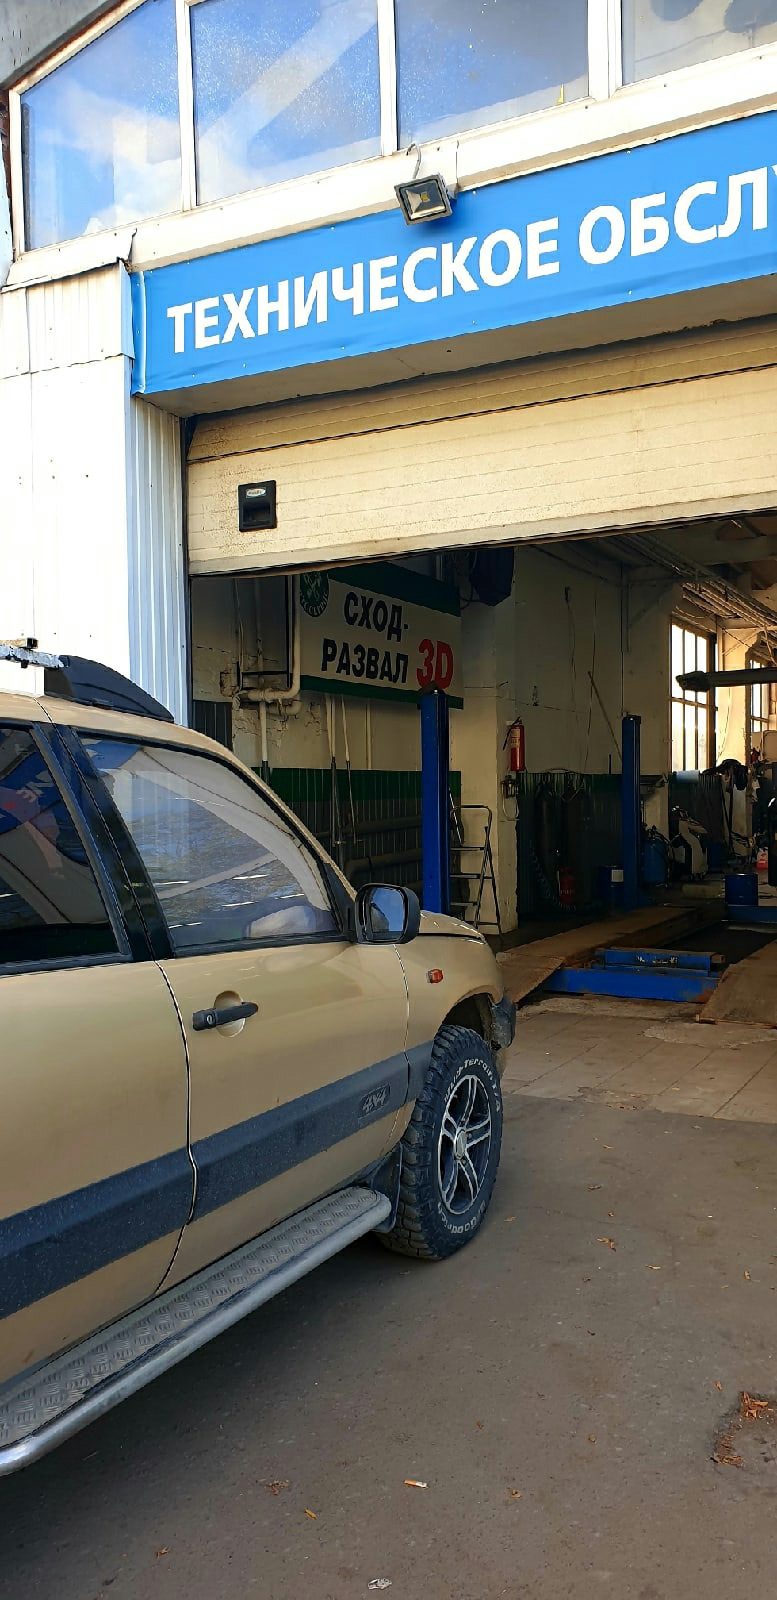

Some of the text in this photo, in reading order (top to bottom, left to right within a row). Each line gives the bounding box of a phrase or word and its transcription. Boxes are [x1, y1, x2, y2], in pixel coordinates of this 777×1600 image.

[167, 164, 777, 354] ТЕХНИЧЕСКОЕ ОБСЛ
[343, 591, 409, 643] СХОД-
[321, 638, 454, 690] РАЗВАЛ 3D
